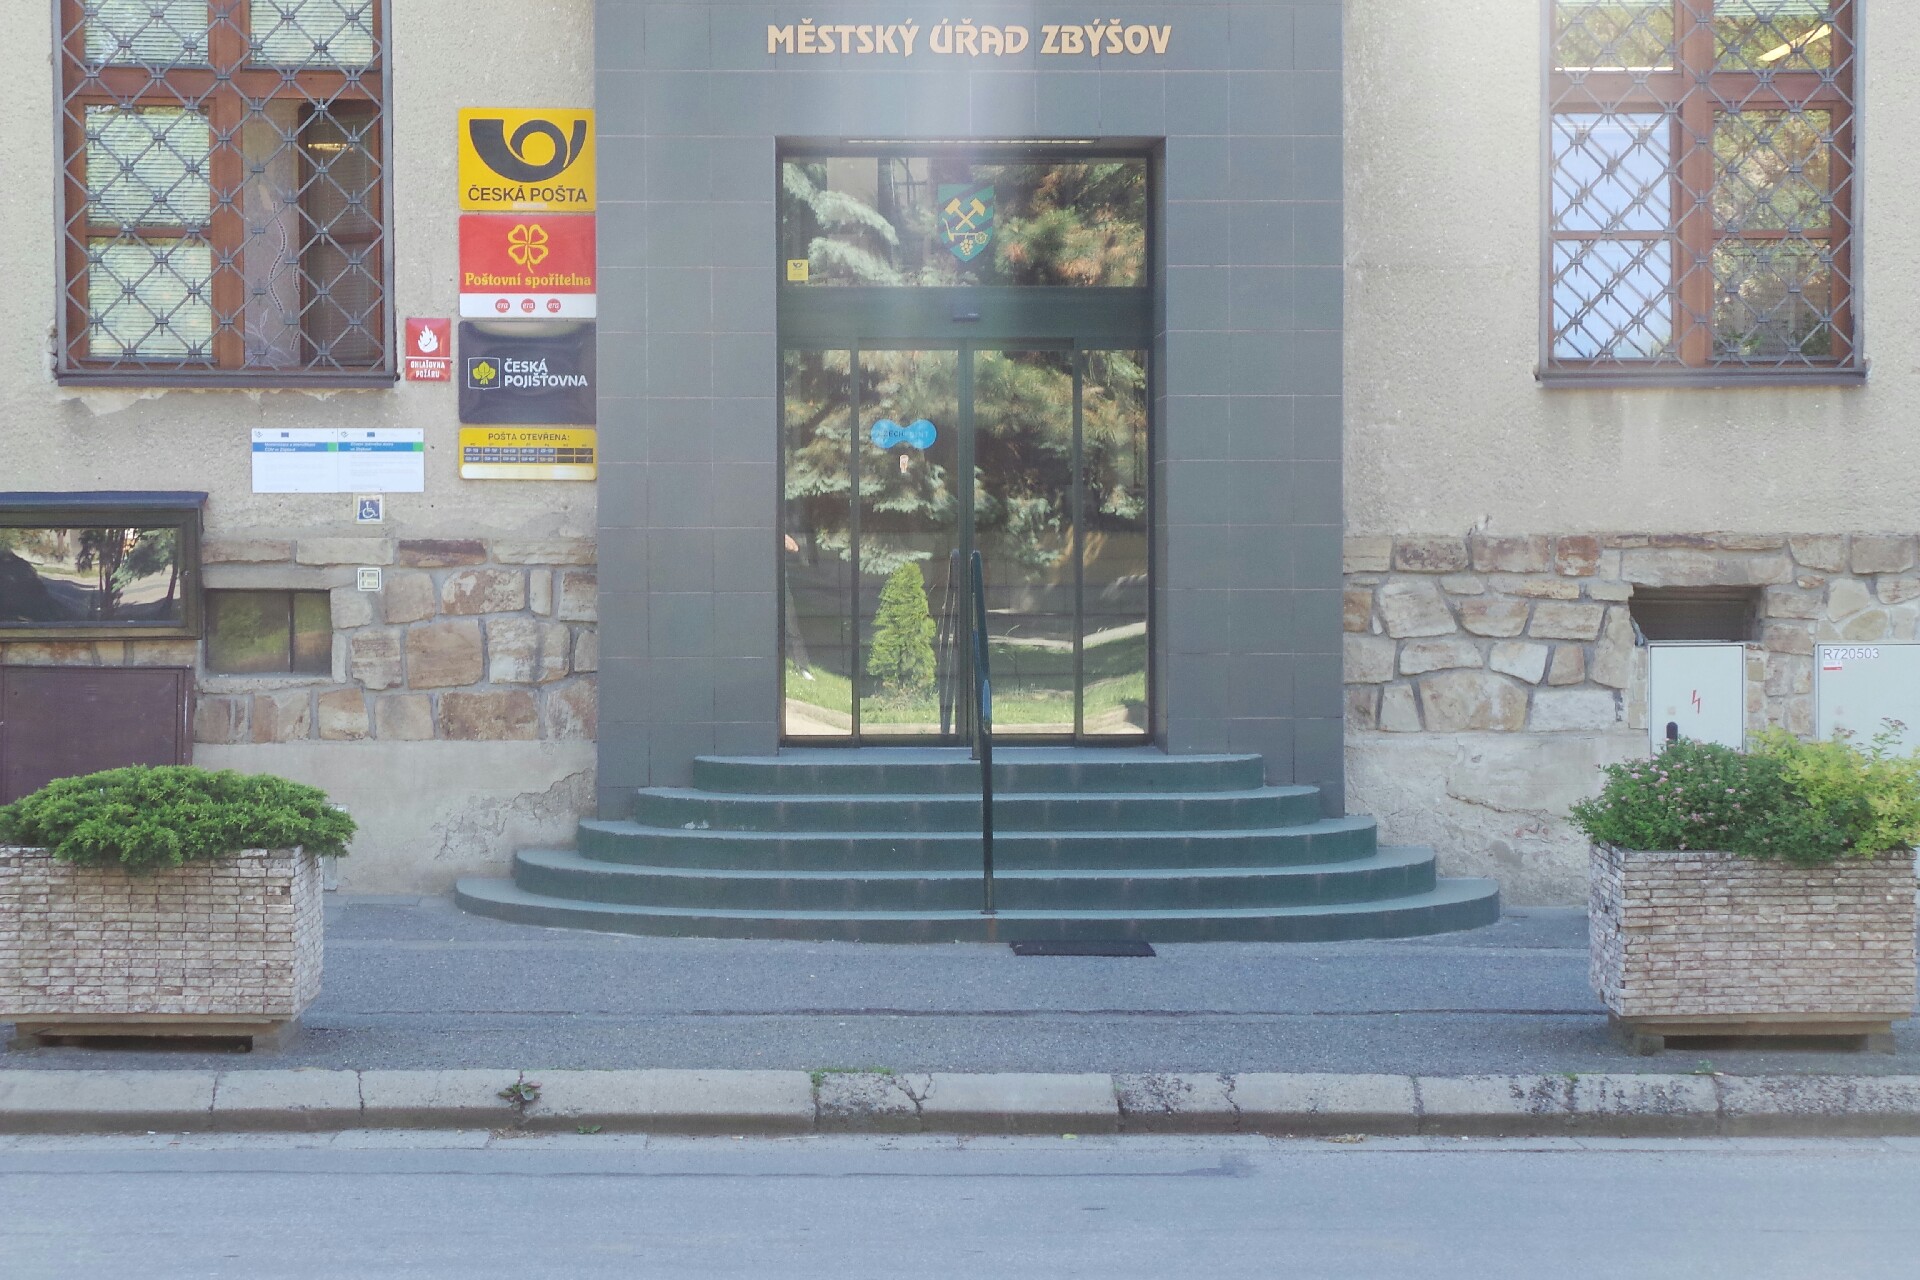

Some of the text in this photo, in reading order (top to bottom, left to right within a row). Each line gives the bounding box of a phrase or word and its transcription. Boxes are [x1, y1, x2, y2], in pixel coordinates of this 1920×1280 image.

[767, 18, 1172, 57] MĚSTSKÝ ÚŘAD ZBÝŠOV
[468, 184, 588, 203] ČESKÁ POŠTA
[465, 272, 592, 288] Poštovní spořitelna
[410, 360, 445, 368] OHLAŠOVNA
[504, 358, 548, 373] ČESKÁ
[415, 368, 440, 378] POŽÁRU
[504, 372, 588, 389] POJIŠŤOVNA
[488, 432, 571, 441] POŠTA OTEVŘENA:
[1823, 648, 1880, 660] R720503
